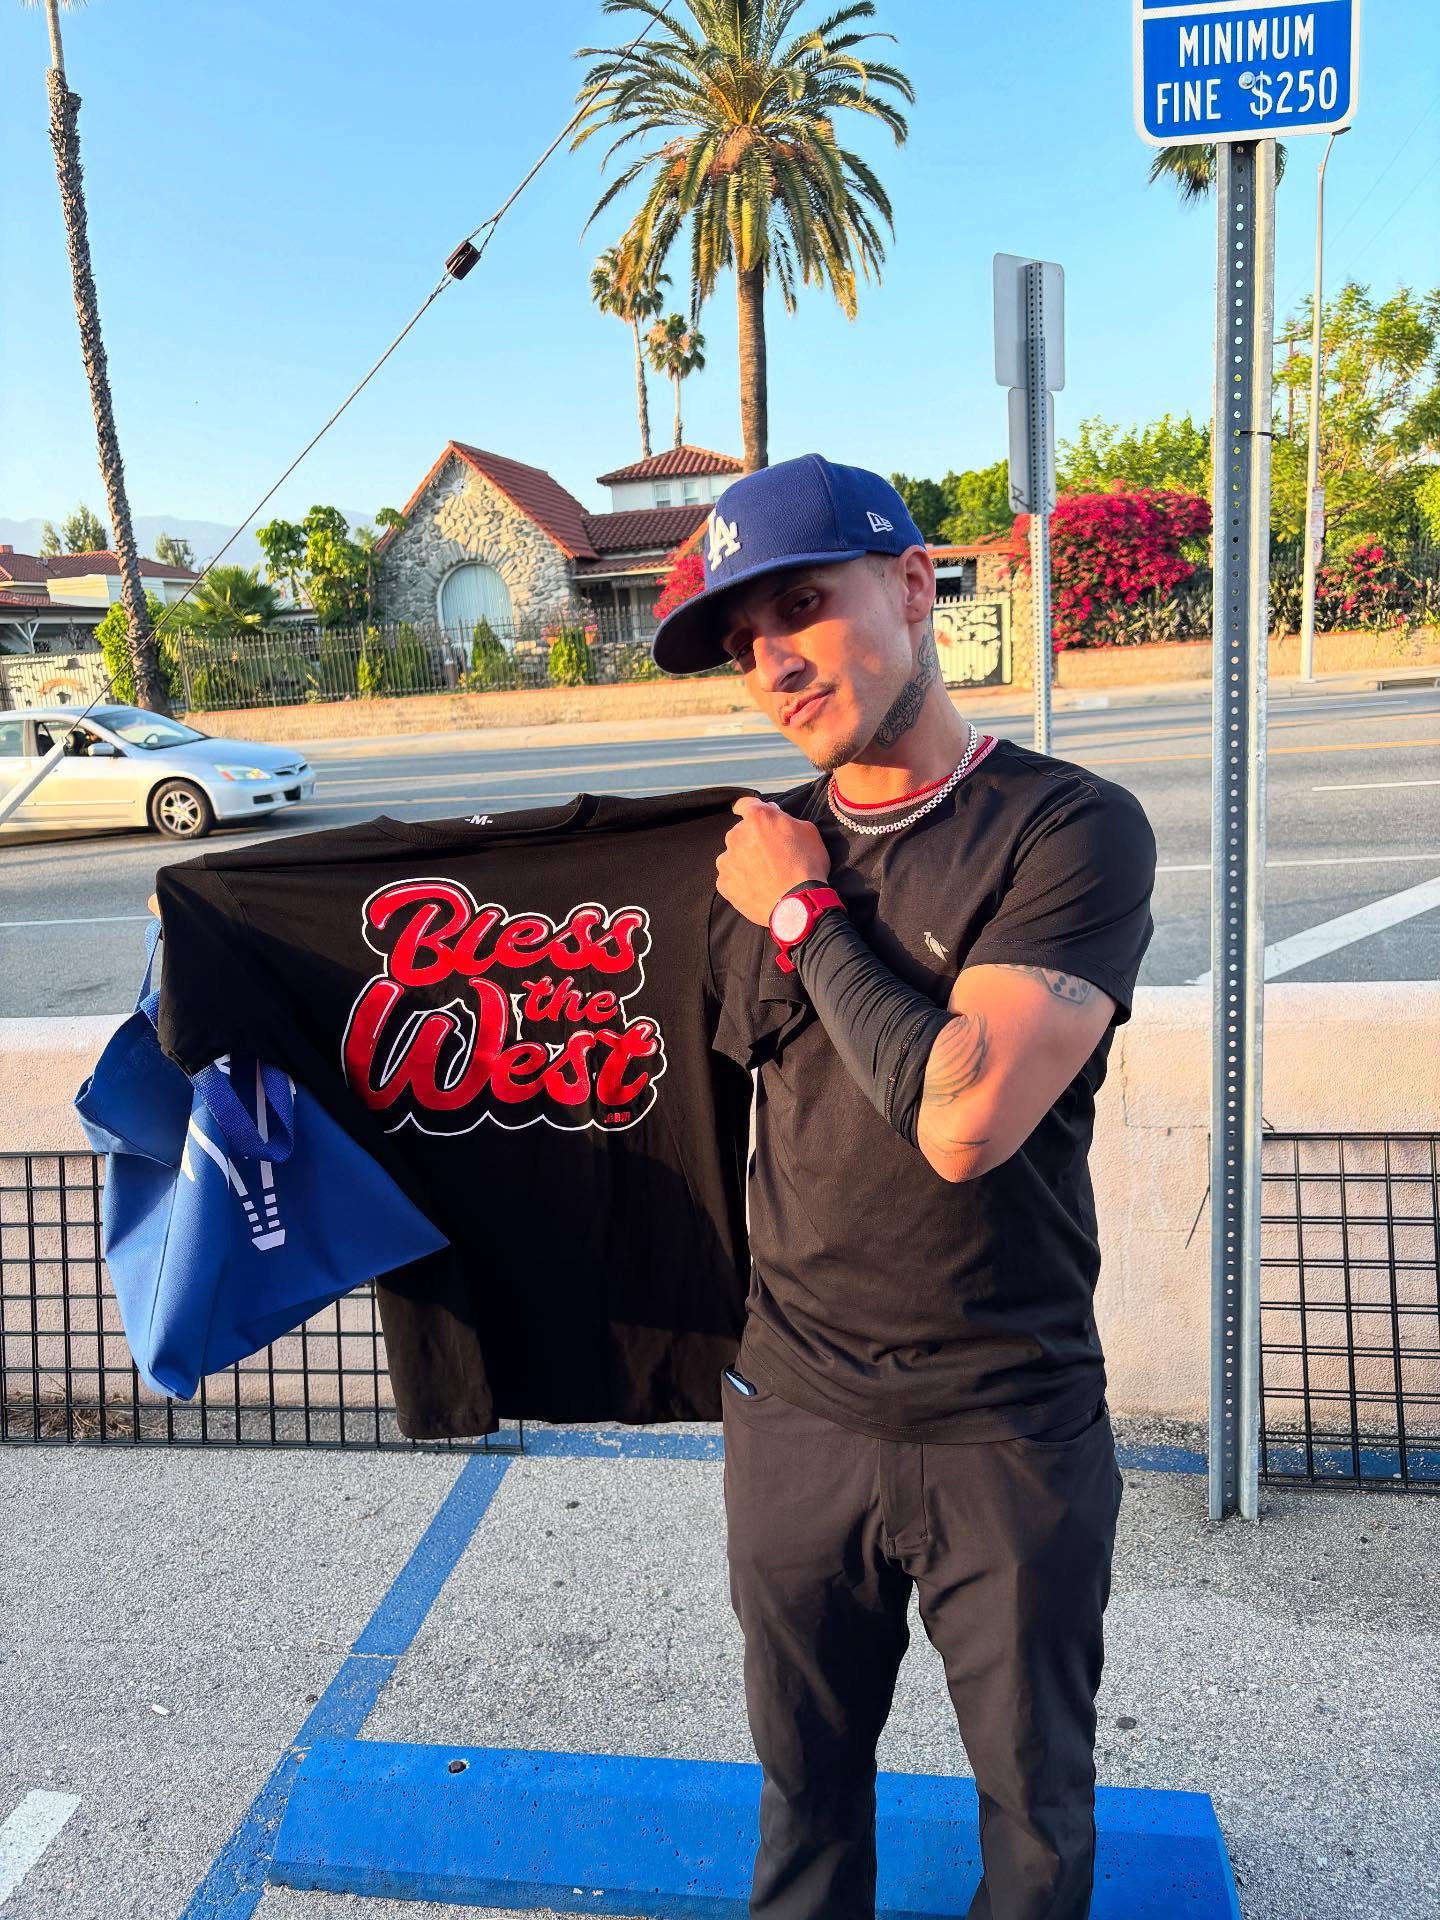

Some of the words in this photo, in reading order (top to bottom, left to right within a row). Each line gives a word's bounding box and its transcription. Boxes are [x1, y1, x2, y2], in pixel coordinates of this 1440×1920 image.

[1179, 14, 1315, 67] MINIMUM
[1157, 78, 1222, 124] FINE
[1249, 66, 1338, 120] $250
[708, 507, 741, 571] LA
[368, 882, 643, 986] Bless
[521, 975, 618, 1024] the
[346, 977, 658, 1111] West
